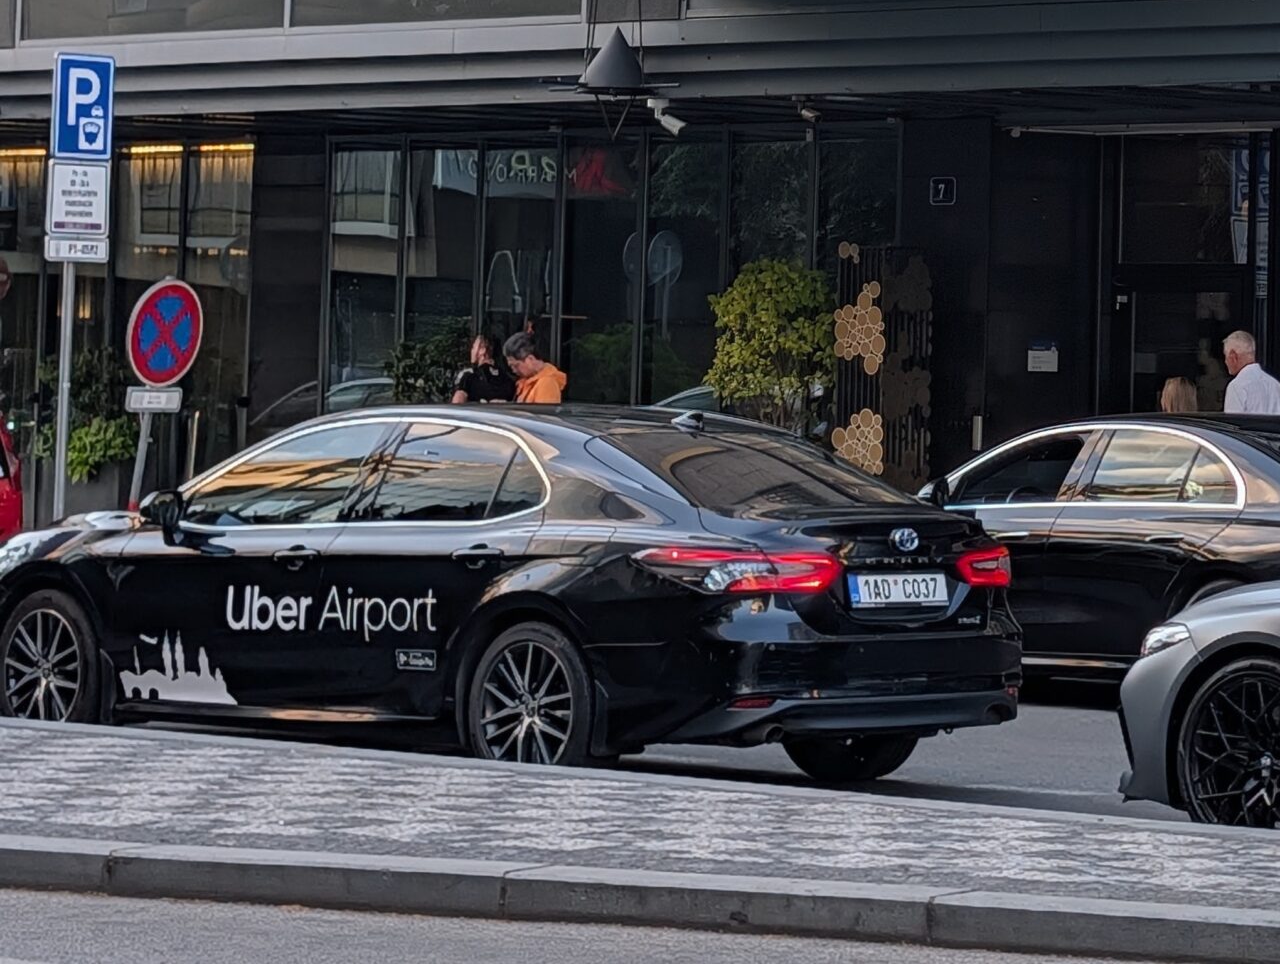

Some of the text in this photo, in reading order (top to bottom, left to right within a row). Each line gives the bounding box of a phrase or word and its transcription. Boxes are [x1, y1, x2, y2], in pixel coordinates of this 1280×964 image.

[67, 67, 101, 126] P
[938, 183, 945, 199] 7
[226, 585, 436, 641] Uber Airport
